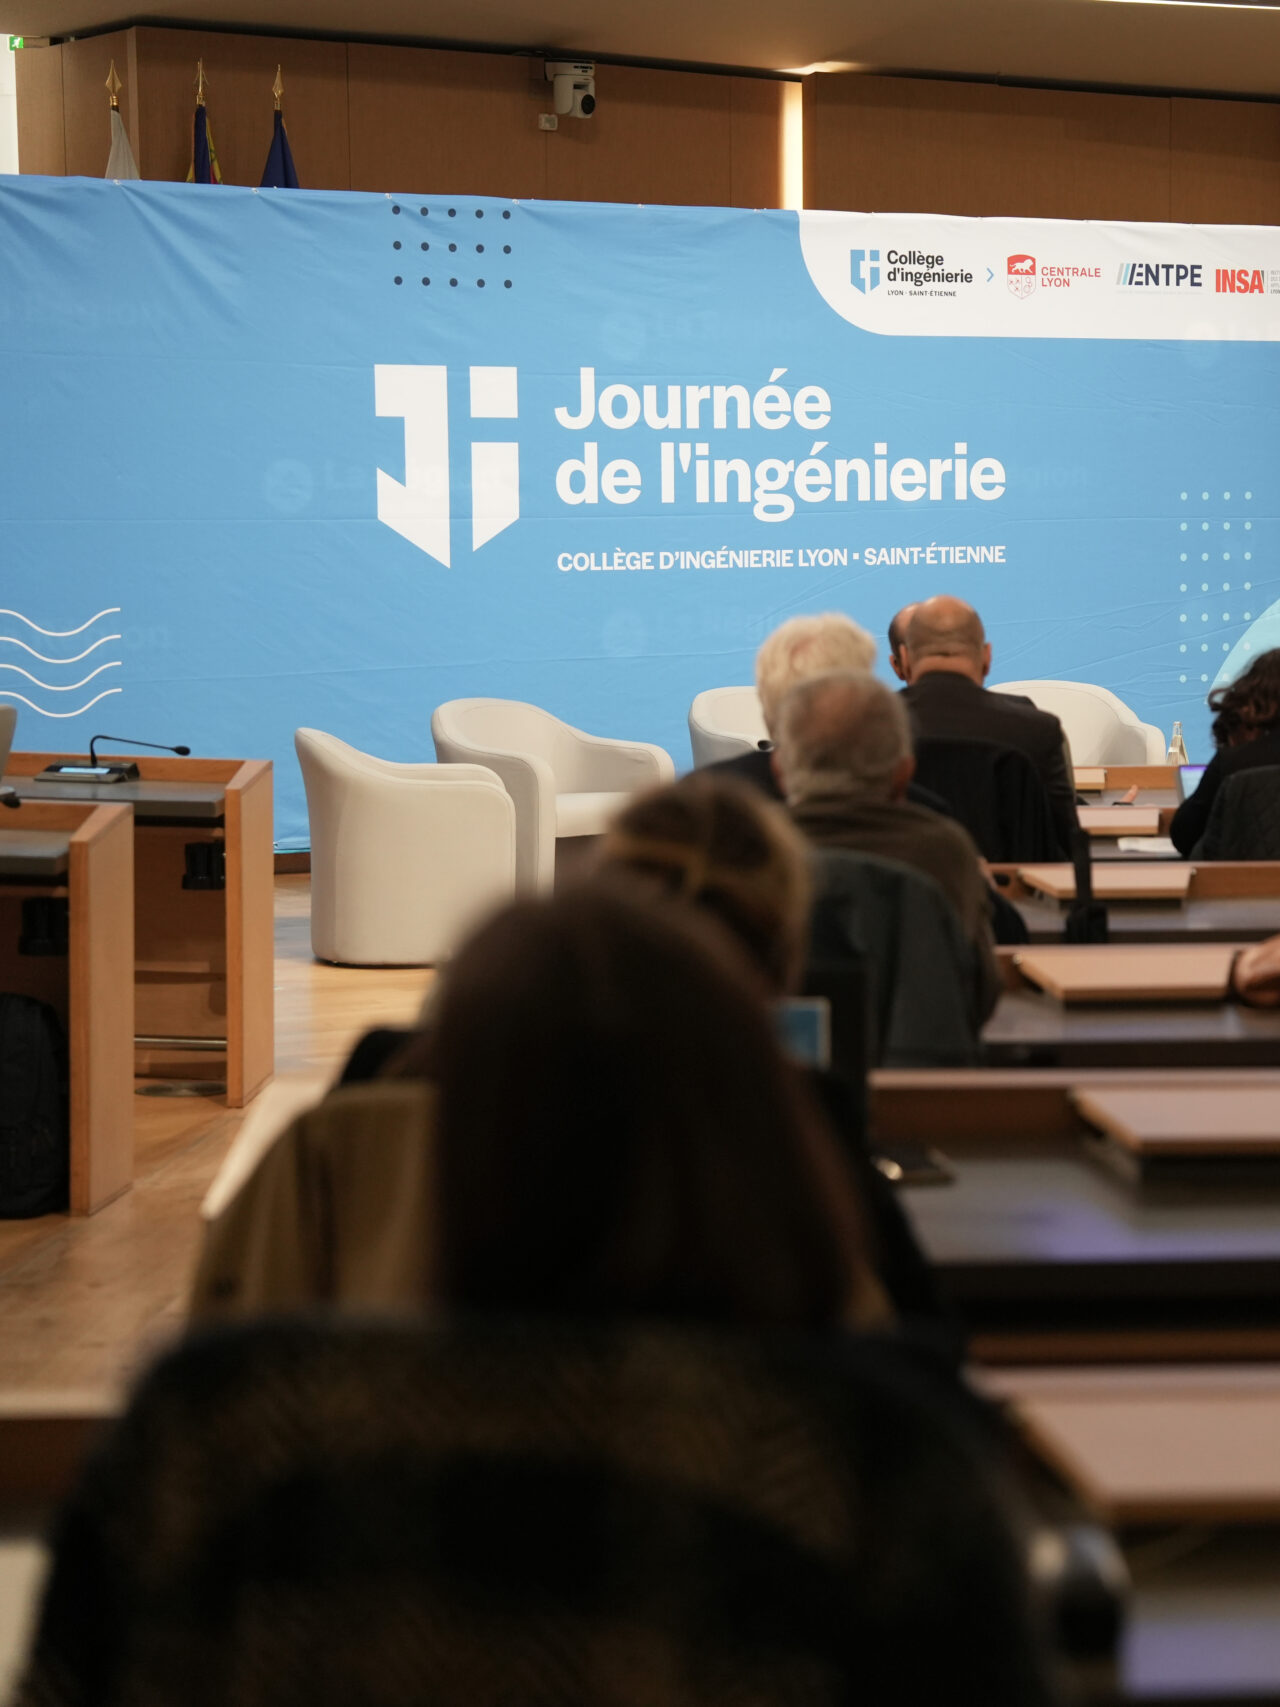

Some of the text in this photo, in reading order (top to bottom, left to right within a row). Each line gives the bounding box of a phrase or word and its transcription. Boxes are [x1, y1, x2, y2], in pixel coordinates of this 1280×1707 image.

[886, 250, 945, 270] Collège
[1041, 266, 1102, 278] CENTRALE
[886, 267, 974, 287] d'ingénierie
[1041, 277, 1070, 288] LYON
[1128, 263, 1203, 287] ENTPE
[1215, 268, 1264, 294] INSA
[554, 367, 831, 430] Journée
[555, 442, 1007, 523] de l'ingénierie
[557, 547, 654, 572] COLLÈGE
[798, 548, 849, 567] LYON
[864, 541, 1007, 567] SAINT-ÉTIENNE
